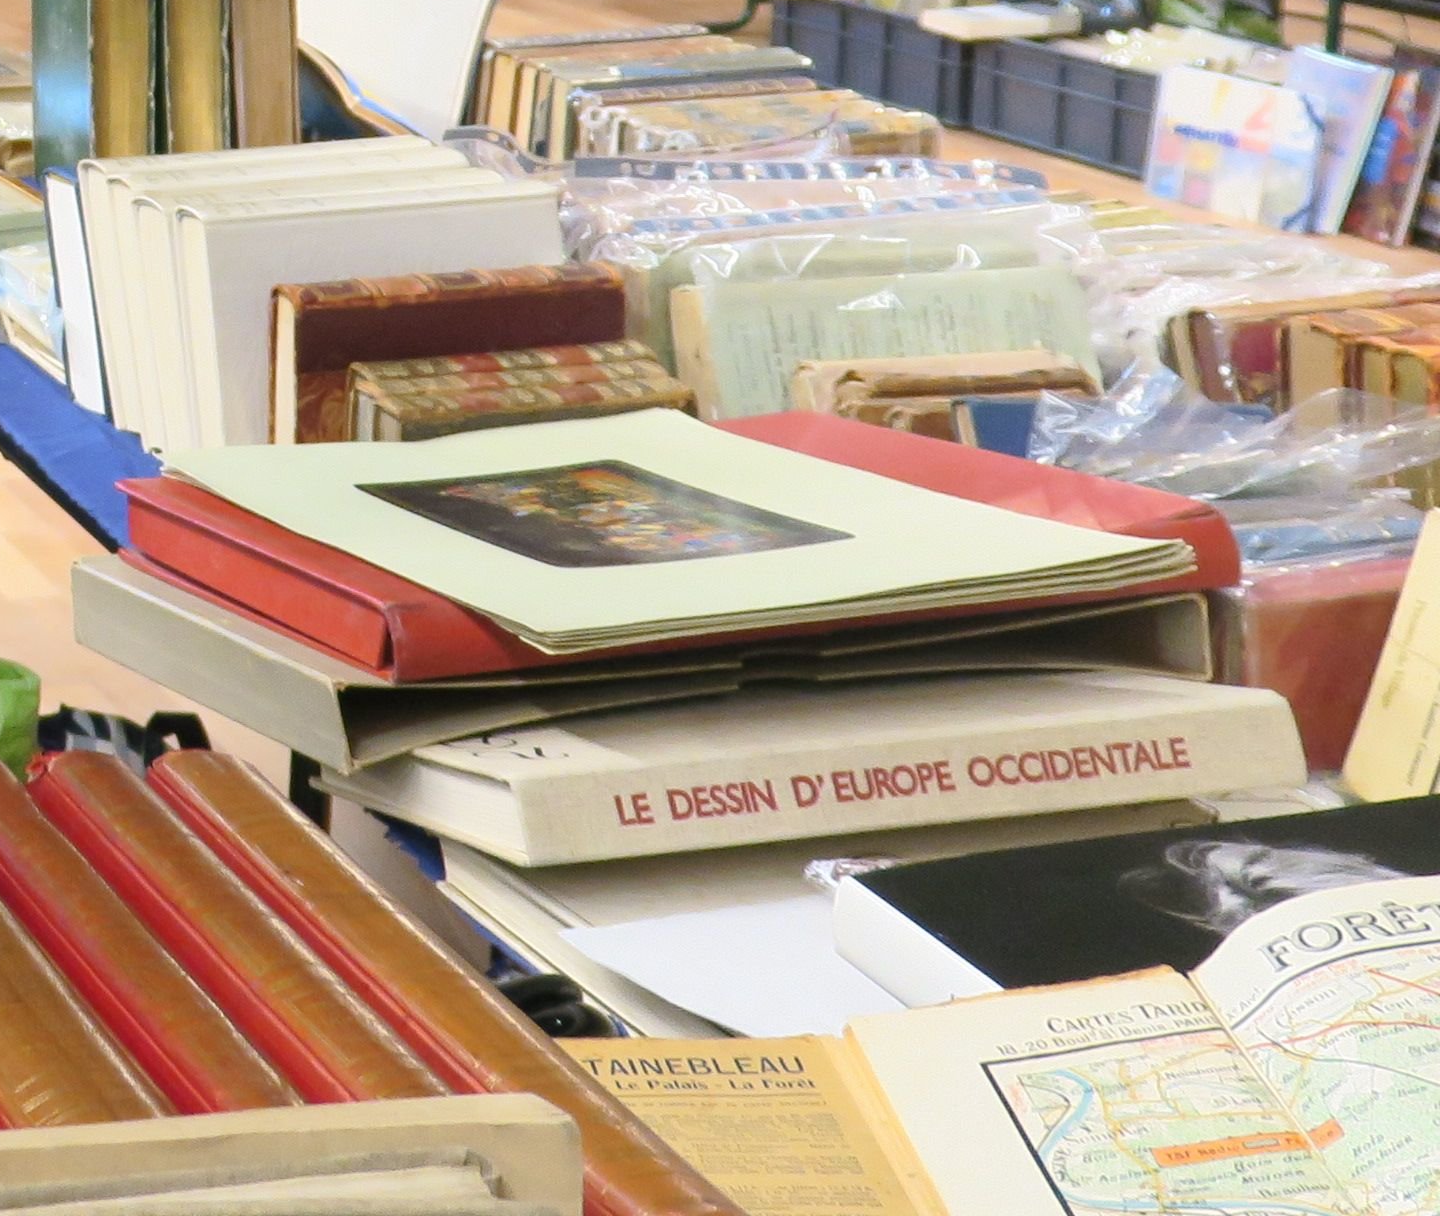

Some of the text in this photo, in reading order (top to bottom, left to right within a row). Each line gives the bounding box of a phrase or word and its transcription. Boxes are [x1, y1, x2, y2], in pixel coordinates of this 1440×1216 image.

[614, 793, 655, 826] LE
[669, 780, 778, 821] DESSIN
[966, 737, 1192, 786] OCCIDENTALE
[582, 1055, 806, 1076] TAINEBLEAU
[616, 1079, 638, 1091] Le
[648, 1078, 708, 1091] Palais
[729, 1078, 755, 1090] La
